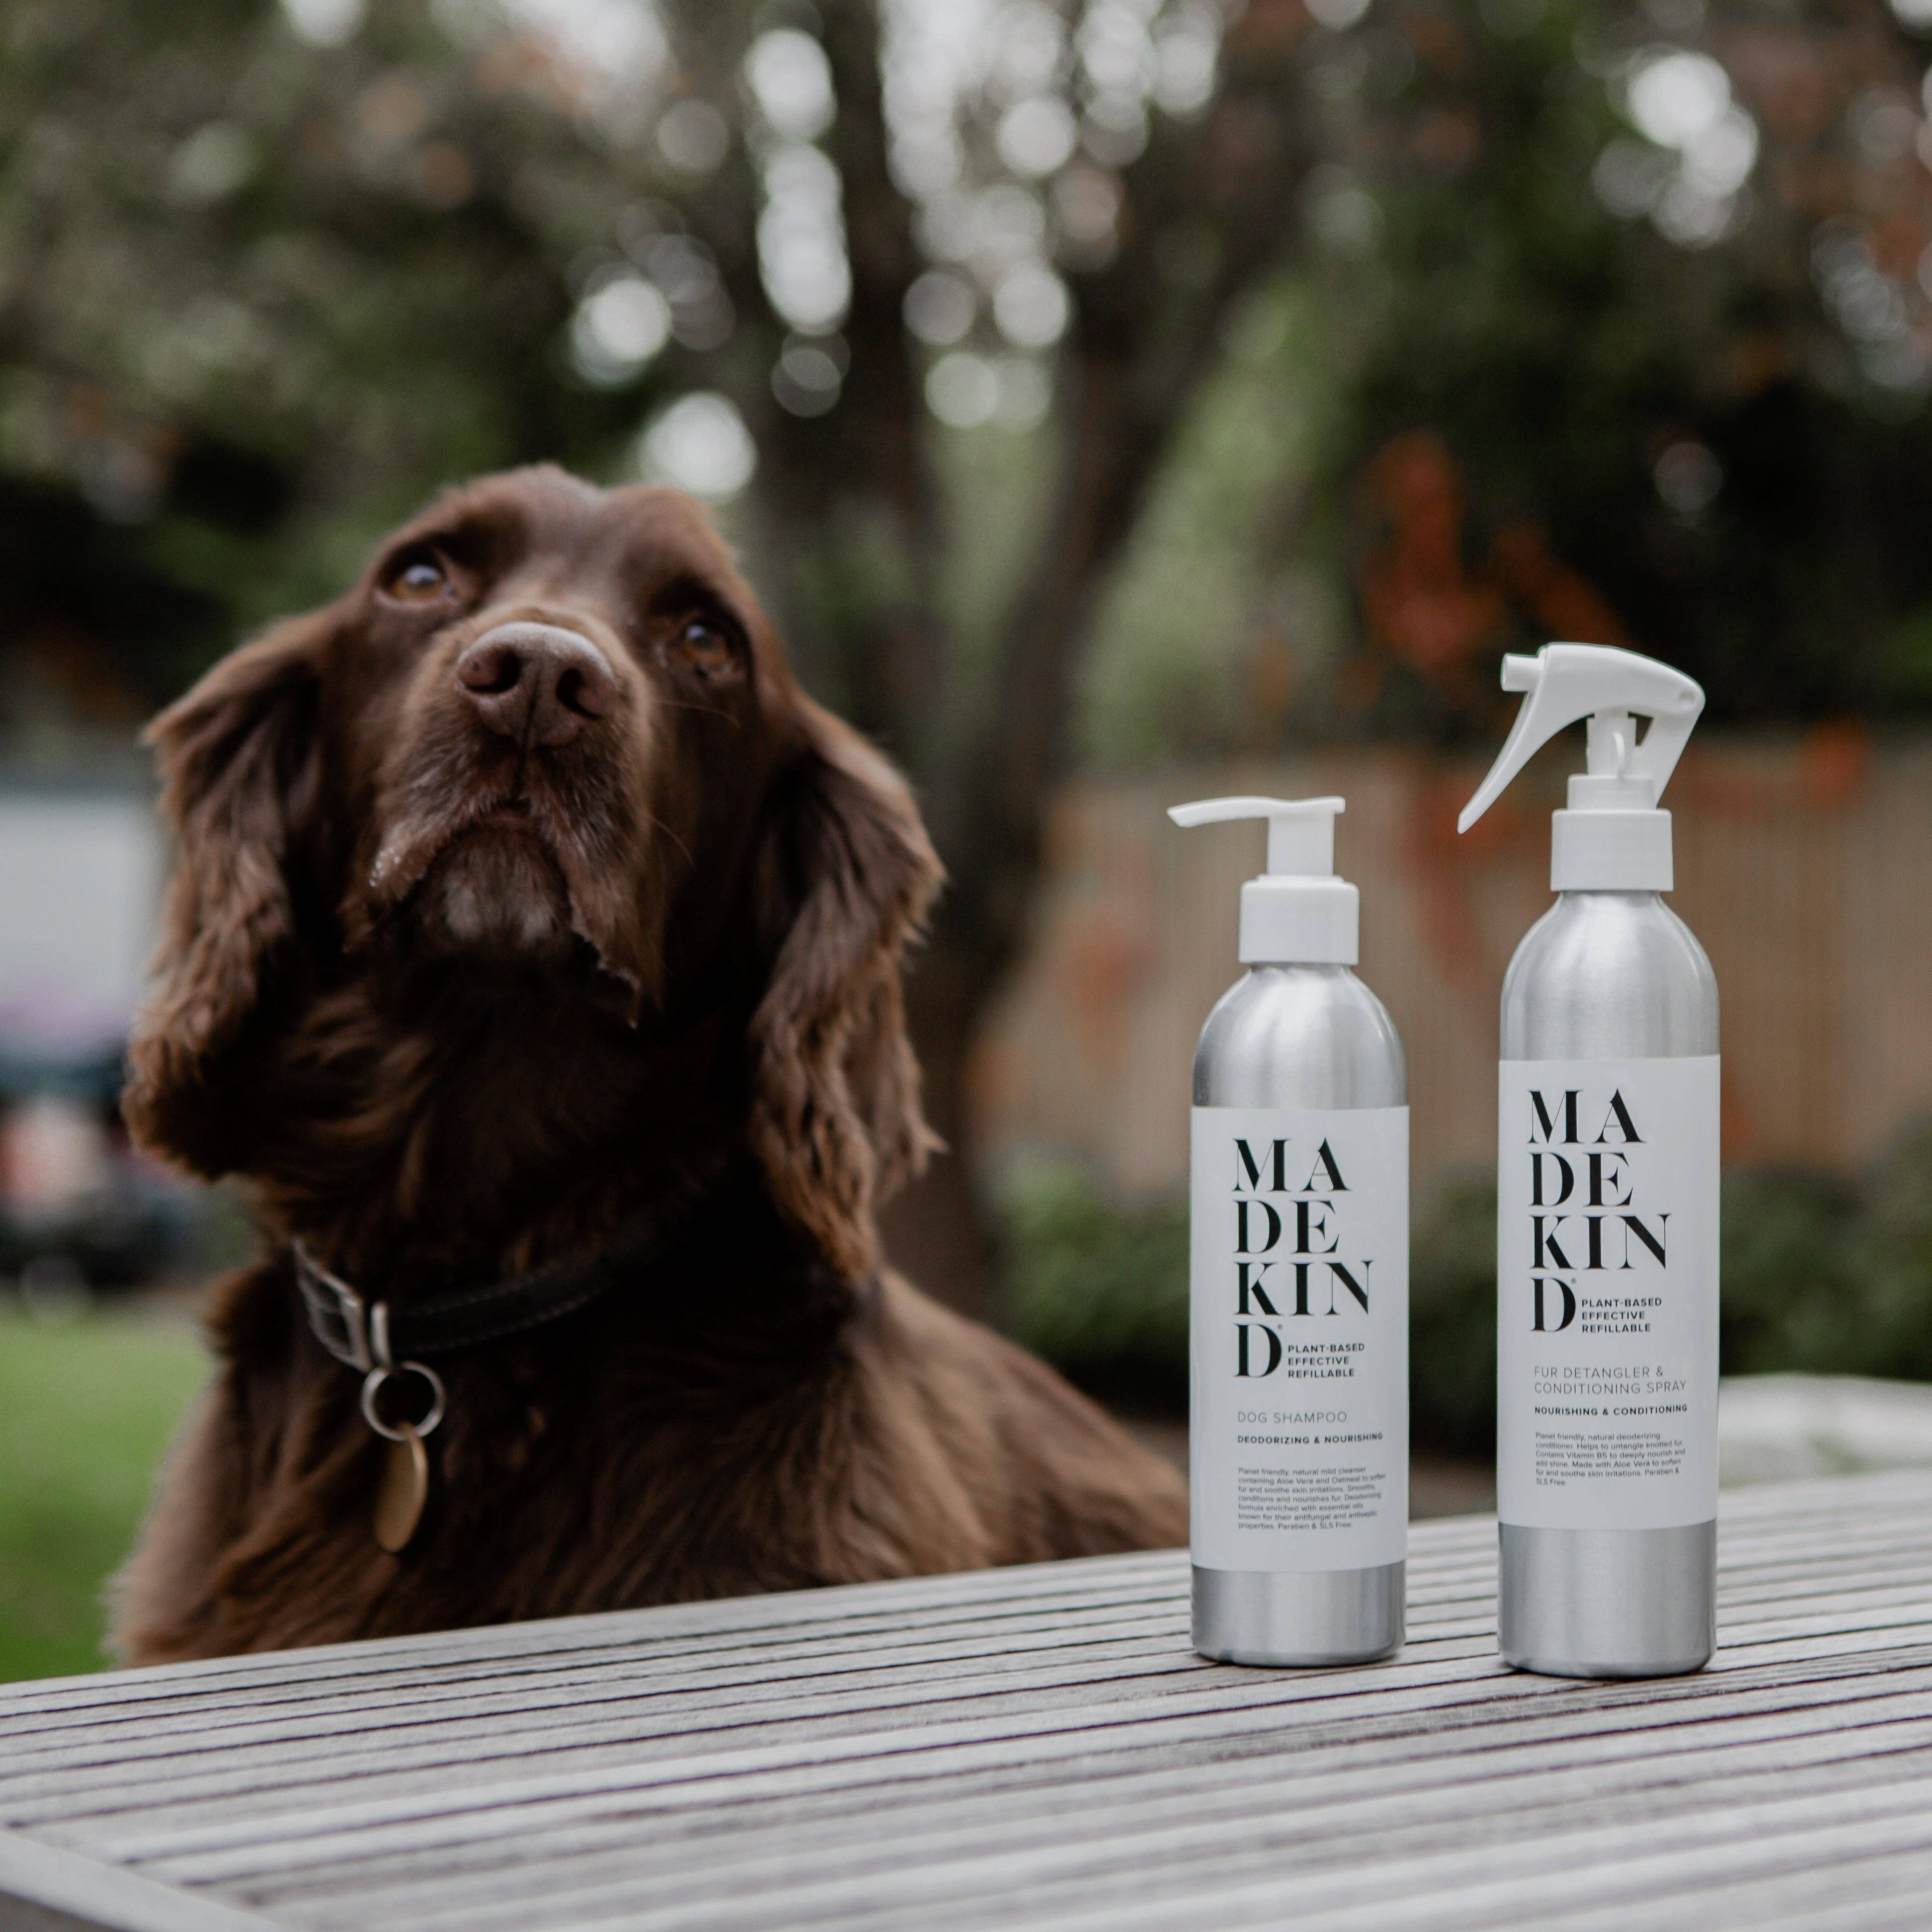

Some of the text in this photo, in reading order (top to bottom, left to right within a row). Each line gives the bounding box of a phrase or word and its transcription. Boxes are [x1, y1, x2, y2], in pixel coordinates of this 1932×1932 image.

[1527, 1087, 1647, 1144] MA
[1232, 1138, 1351, 1191] MA
[1528, 1152, 1633, 1207] DE
[1233, 1200, 1339, 1254] DE
[1529, 1213, 1672, 1270] KIN
[1234, 1260, 1375, 1316] KIN
[1582, 1298, 1662, 1308] PLANT-BASED
[1582, 1311, 1645, 1320] EFFECTIVE
[1582, 1323, 1651, 1333] REFILLABLE
[1288, 1343, 1364, 1352] PLANT-BASED
[1288, 1356, 1349, 1365] EFFECTIVE
[1288, 1368, 1354, 1378] REFILLABLE
[1535, 1365, 1663, 1379] FUR DETANGLER &
[1535, 1380, 1686, 1395] CONDITIONING SPRAY
[1535, 1407, 1598, 1415] NOURISHING
[1614, 1404, 1687, 1415] CONDITIONING
[1238, 1411, 1347, 1423] DOG SHAMPOO
[1238, 1435, 1309, 1444] DEODORIZING
[1325, 1432, 1383, 1443] NOURISHING
[1558, 1433, 1586, 1441] friendly,
[1536, 1450, 1564, 1458] Contains
